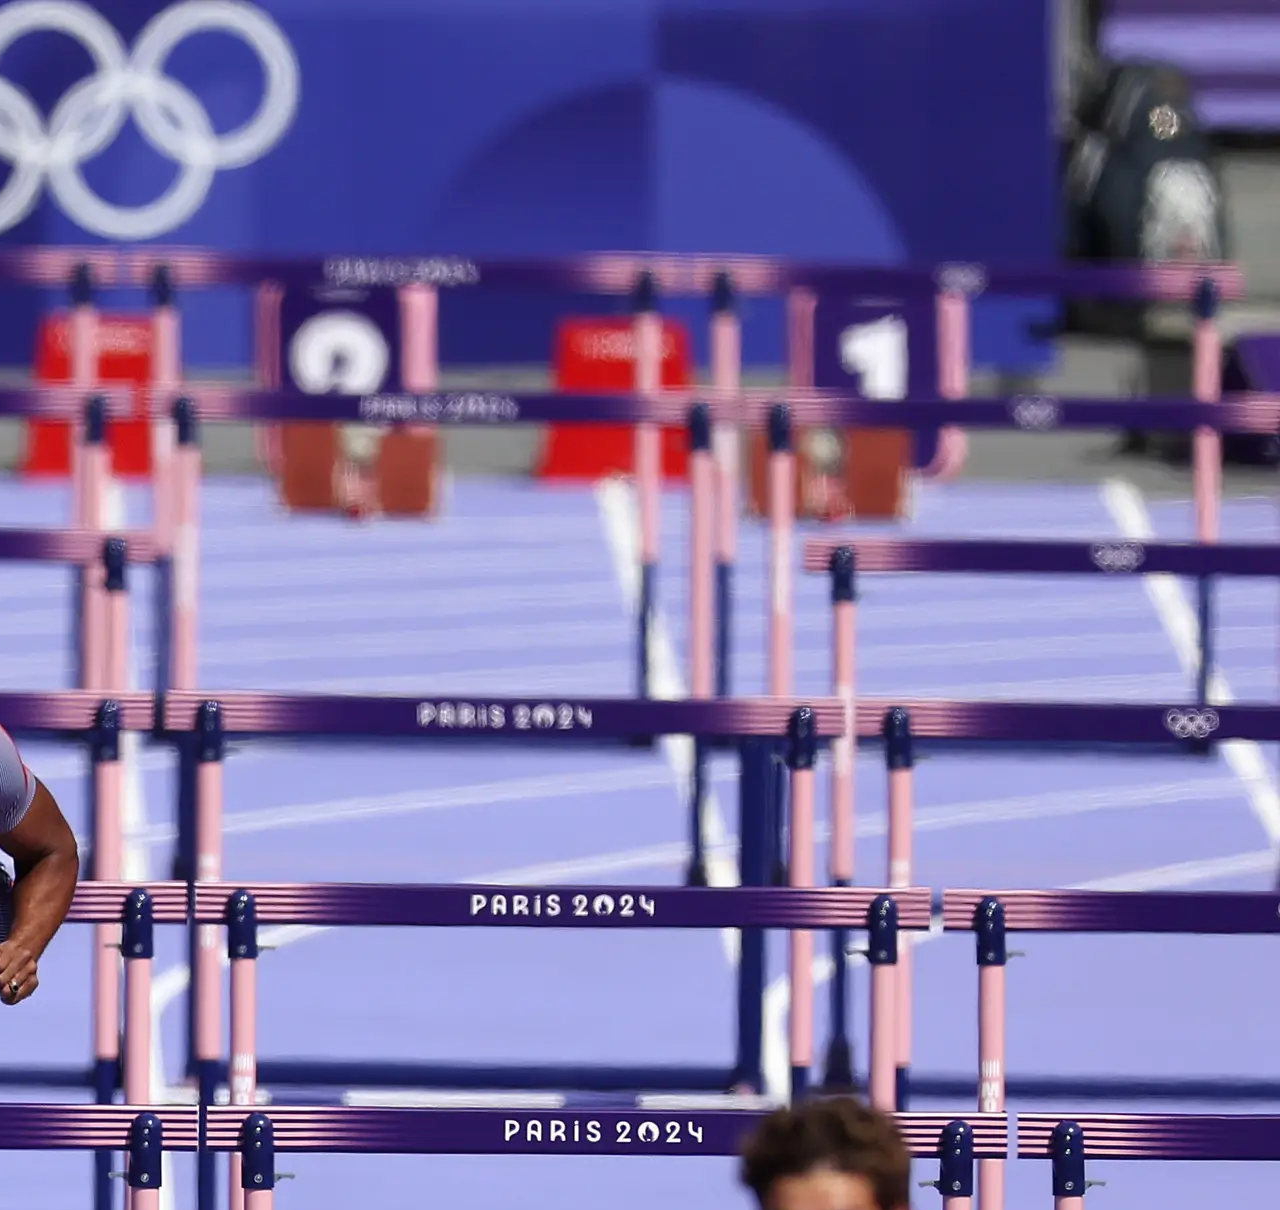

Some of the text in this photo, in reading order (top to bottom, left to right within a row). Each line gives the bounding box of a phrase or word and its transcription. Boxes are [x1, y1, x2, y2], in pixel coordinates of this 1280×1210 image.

[470, 894, 655, 917] PARIS 2024
[505, 1120, 703, 1143] PARIS 2024
